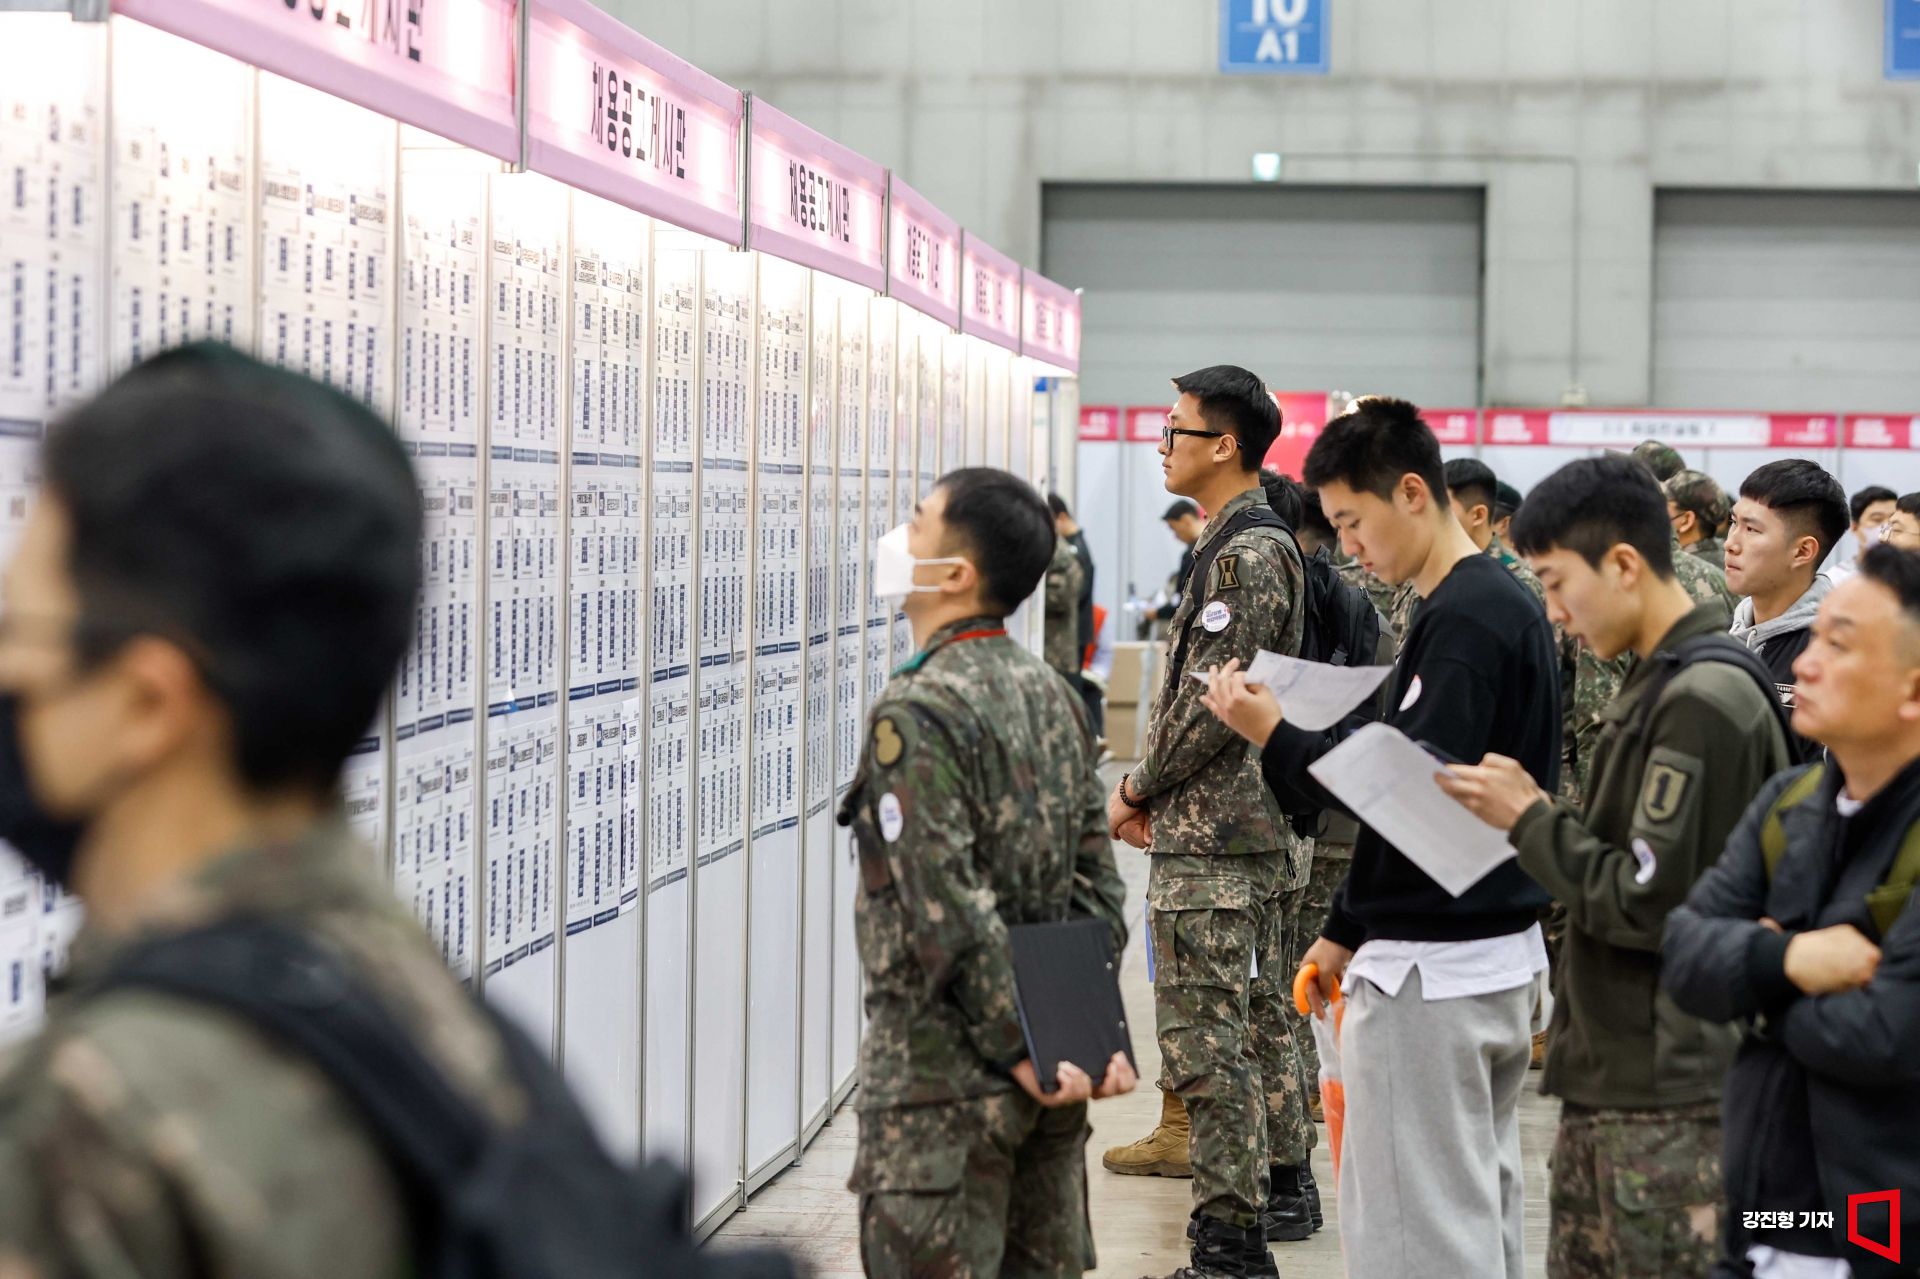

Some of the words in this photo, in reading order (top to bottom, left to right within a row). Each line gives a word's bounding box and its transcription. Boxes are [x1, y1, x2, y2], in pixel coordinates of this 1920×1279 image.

[1256, 29, 1298, 61] A1
[591, 61, 686, 180] 채용공고게시판
[789, 159, 850, 243] 채용공고게시판
